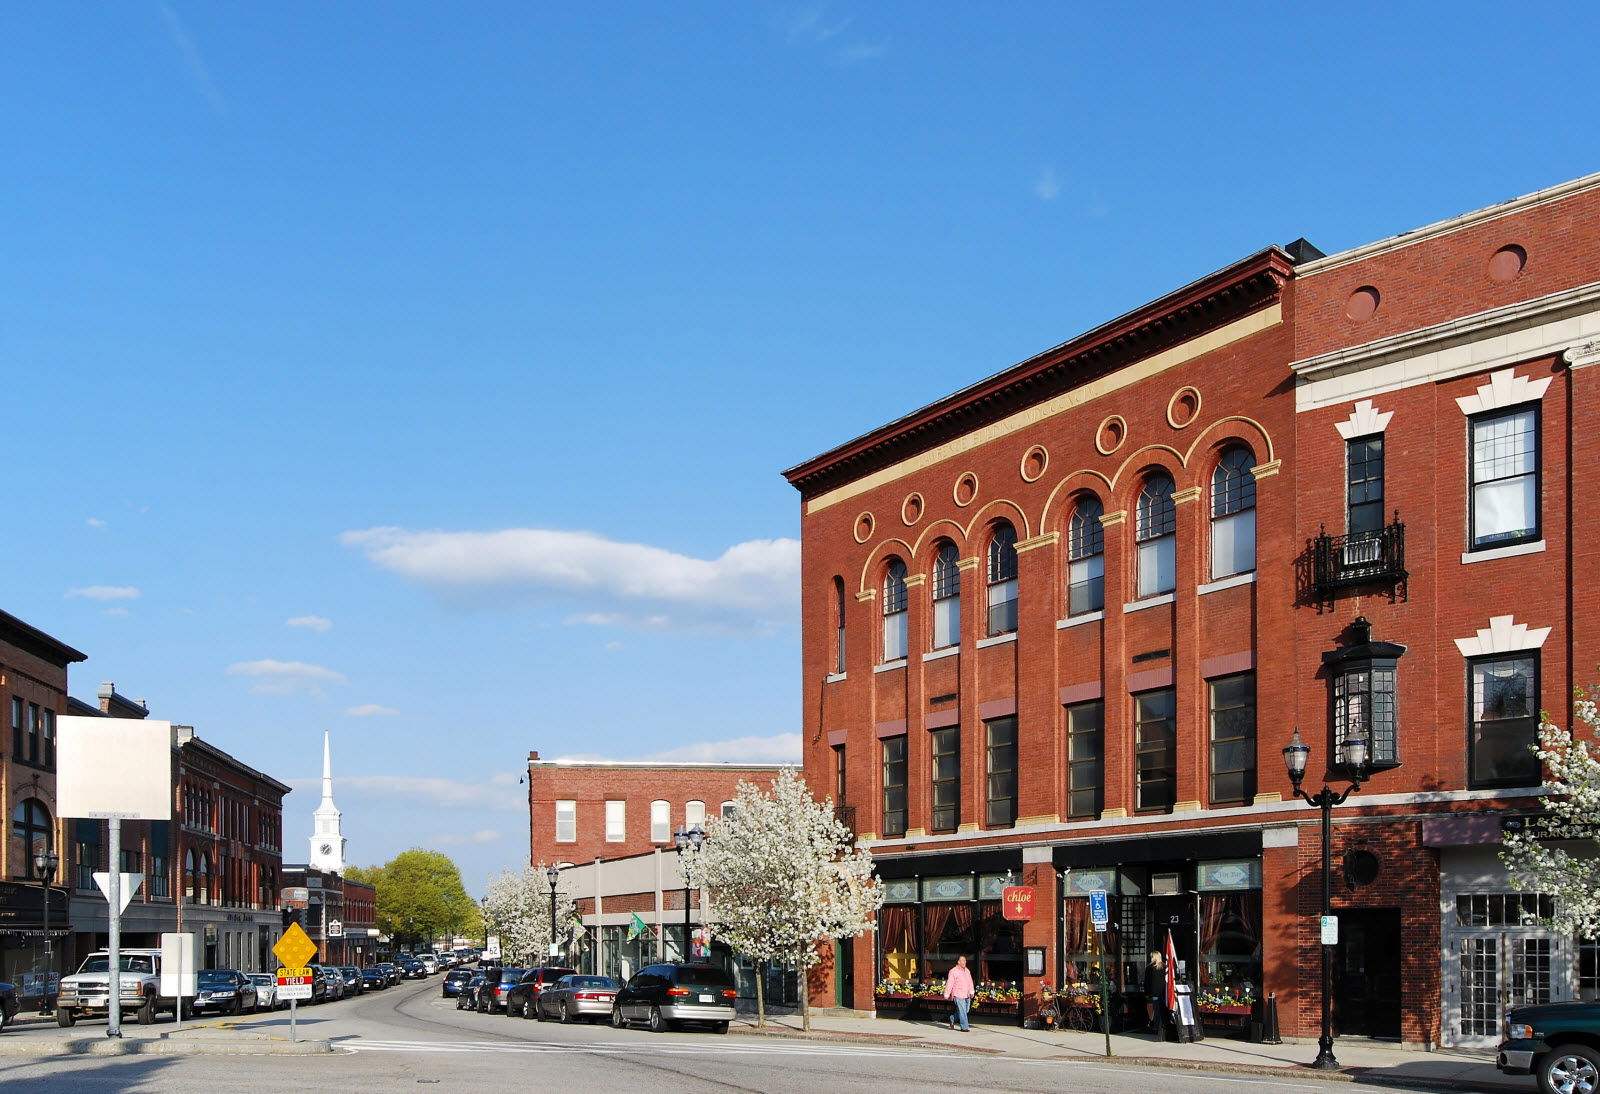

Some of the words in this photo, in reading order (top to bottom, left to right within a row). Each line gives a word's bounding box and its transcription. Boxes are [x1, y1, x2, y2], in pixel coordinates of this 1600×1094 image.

[1007, 890, 1031, 902] chloé
[1170, 915, 1179, 923] 23
[489, 946, 498, 955] 62
[299, 968, 310, 976] LAW
[285, 977, 305, 985] YIELD
